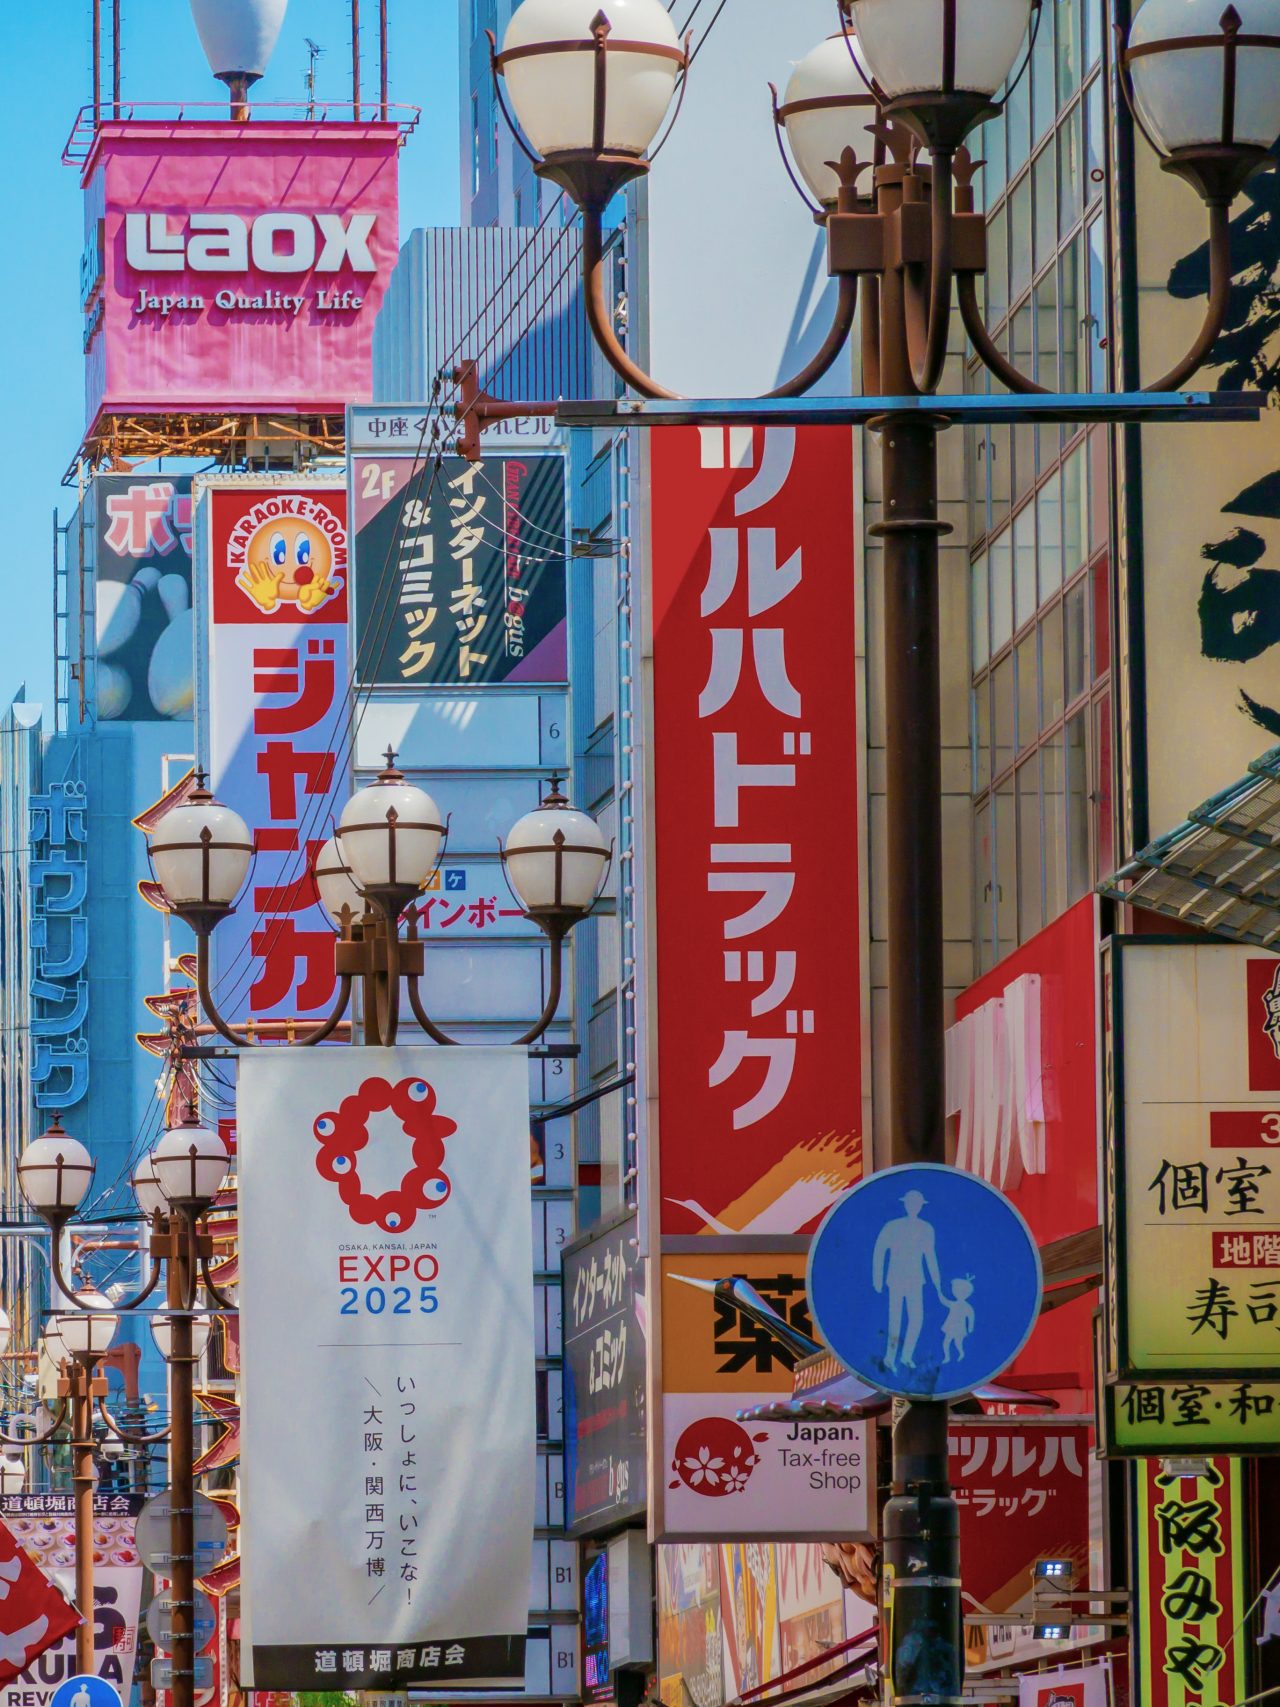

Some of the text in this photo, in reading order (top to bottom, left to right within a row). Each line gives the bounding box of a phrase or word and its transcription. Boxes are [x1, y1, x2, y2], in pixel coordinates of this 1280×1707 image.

[135, 289, 363, 315] Japan Quality Life
[361, 463, 395, 500] 2F
[447, 461, 488, 677] インターネット
[397, 499, 438, 678] &コミック
[548, 721, 561, 740] 6
[698, 427, 815, 1131] ツルハドラッグ
[250, 639, 339, 1040] ジャンカ
[397, 895, 525, 930] インボー
[28, 780, 89, 1108] ボウリング
[552, 1058, 563, 1075] 3
[554, 1143, 565, 1160] 3
[1147, 1156, 1272, 1216] 個室
[338, 1242, 438, 1251] OSAKA, KANSAI, JAPAN
[555, 1227, 566, 1245] 3
[1219, 1234, 1280, 1266] 地階
[338, 1254, 439, 1283] EXPO
[572, 1239, 627, 1328] インターネット
[339, 1286, 439, 1315] 2025
[1185, 1276, 1280, 1341] 寿司
[786, 1422, 860, 1449] Japan.
[777, 1449, 861, 1468] Tax-free
[947, 1436, 1083, 1478] ツルハ
[809, 1471, 861, 1494] Shop
[951, 1488, 1057, 1517] ドラッグ
[555, 1566, 572, 1584] B1
[1156, 1462, 1223, 1707] 阪みや
[314, 1643, 466, 1673] 道頓堀商店会
[557, 1650, 574, 1668] B1
